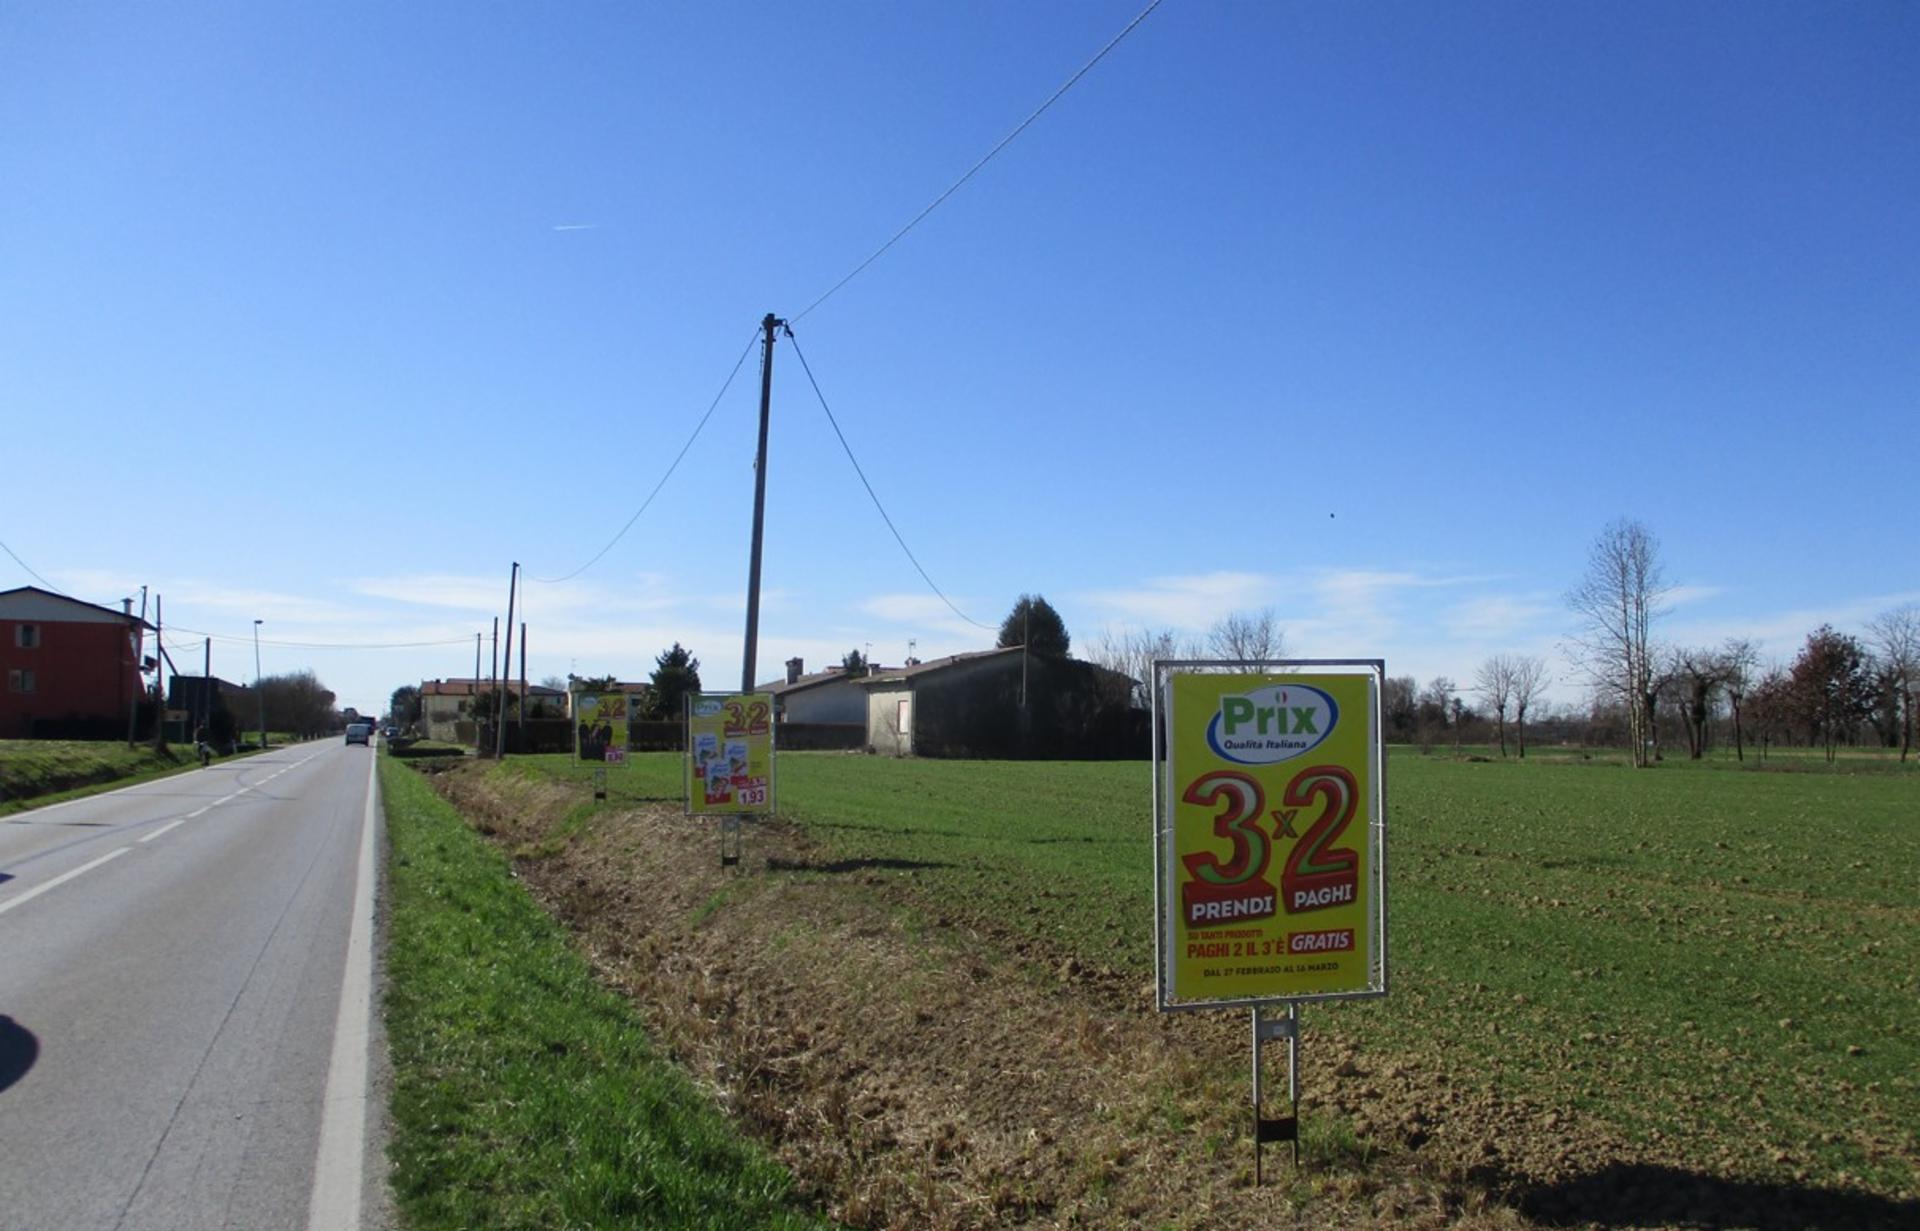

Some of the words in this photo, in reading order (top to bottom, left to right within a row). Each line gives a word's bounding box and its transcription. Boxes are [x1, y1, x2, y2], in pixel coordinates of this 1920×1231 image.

[1222, 691, 1319, 735] Prix
[1266, 739, 1307, 750] Italiana
[1294, 884, 1353, 908] PAGHI
[1192, 896, 1273, 921] PRENDI
[1187, 943, 1230, 958] PAGHI
[1234, 943, 1243, 957] 2
[1247, 942, 1259, 956] IL
[1291, 932, 1350, 951] GRATIS
[1203, 968, 1221, 977] DAL
[1236, 966, 1282, 976] FEBBRAIO
[1284, 965, 1294, 974] AL
[1308, 962, 1339, 972] MARZO
